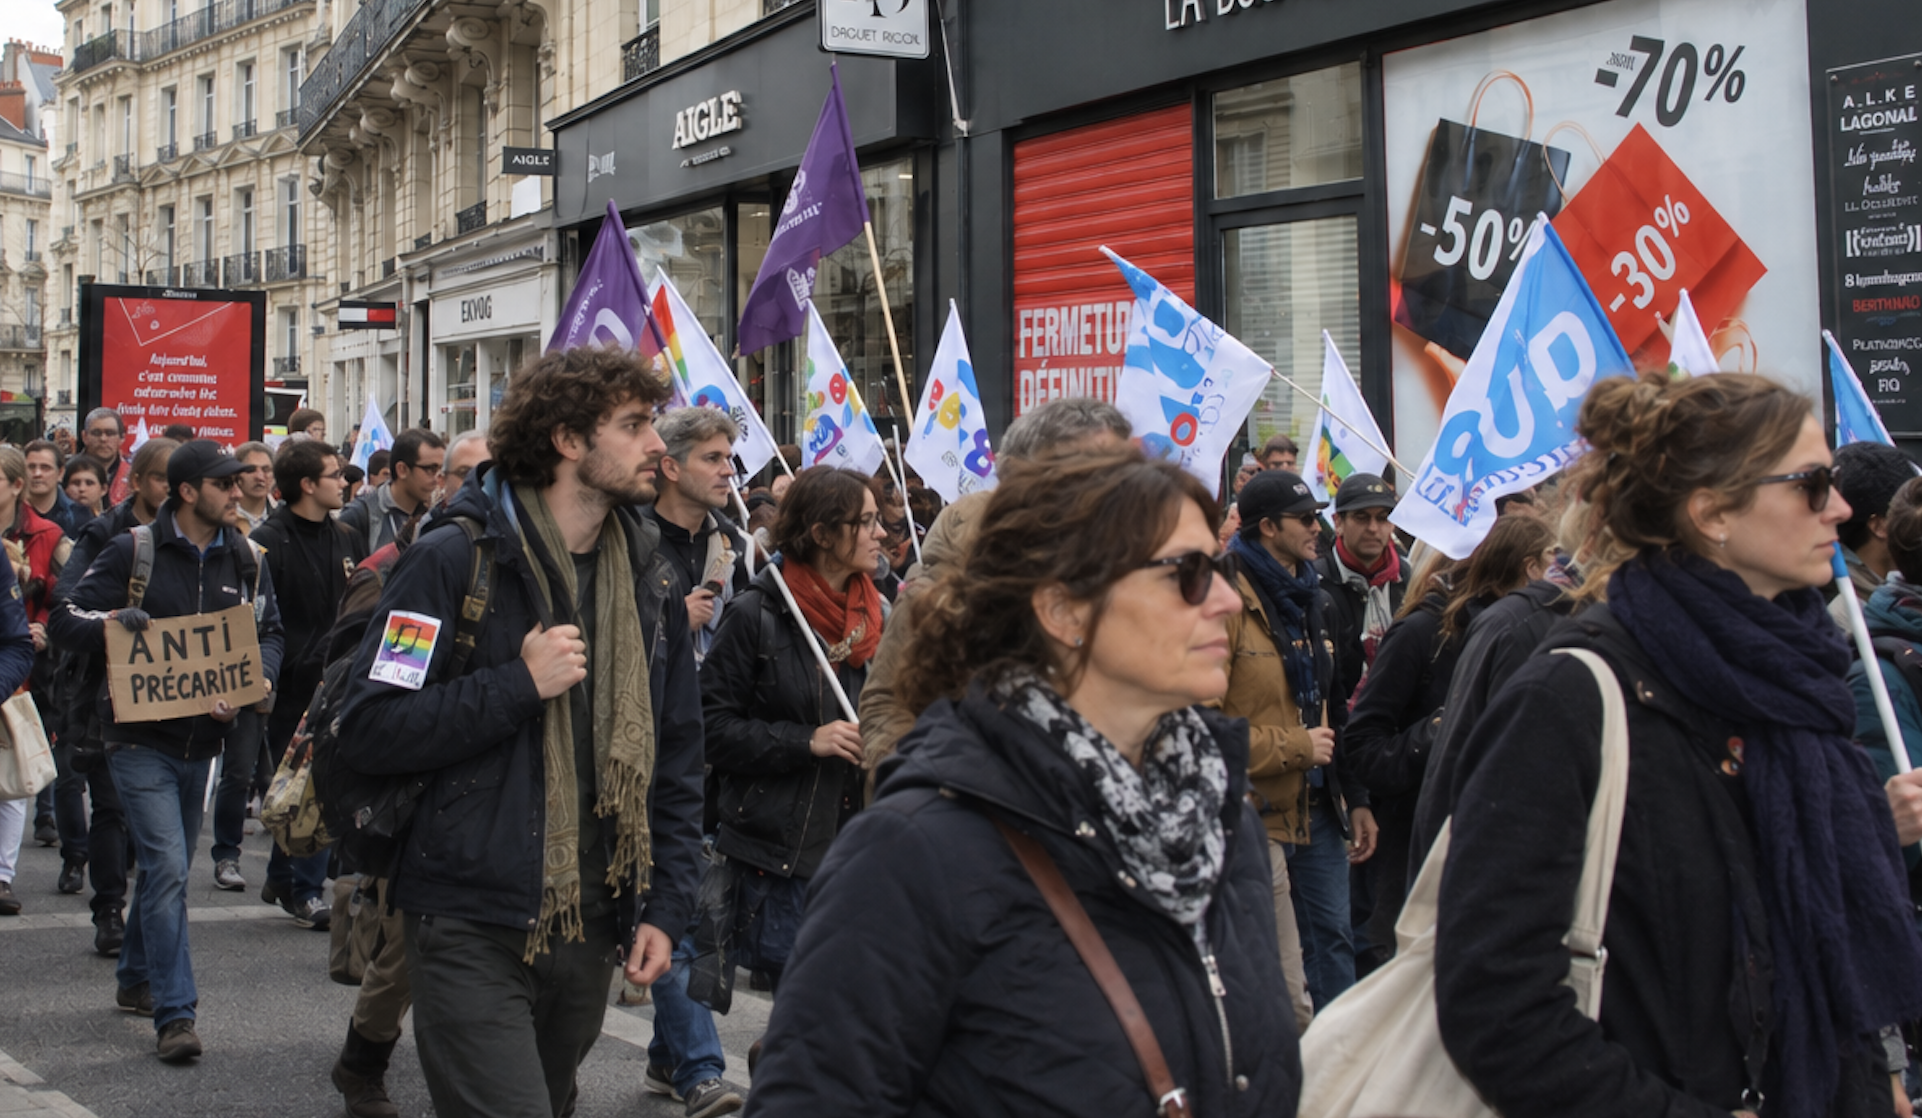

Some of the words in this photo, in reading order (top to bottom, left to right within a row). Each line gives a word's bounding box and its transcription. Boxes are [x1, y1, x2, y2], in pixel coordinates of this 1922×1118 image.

[1594, 34, 1745, 127] -70%
[671, 89, 742, 150] AIGLE
[1841, 106, 1918, 131] LAGONAL
[1420, 195, 1538, 280] -50%
[1609, 194, 1690, 312] -30%
[1019, 301, 1132, 358] FERMETUR
[1019, 358, 1122, 415] DÉFINITI
[128, 616, 231, 665] ANTI
[131, 653, 253, 705] PRÉCARITÉ
